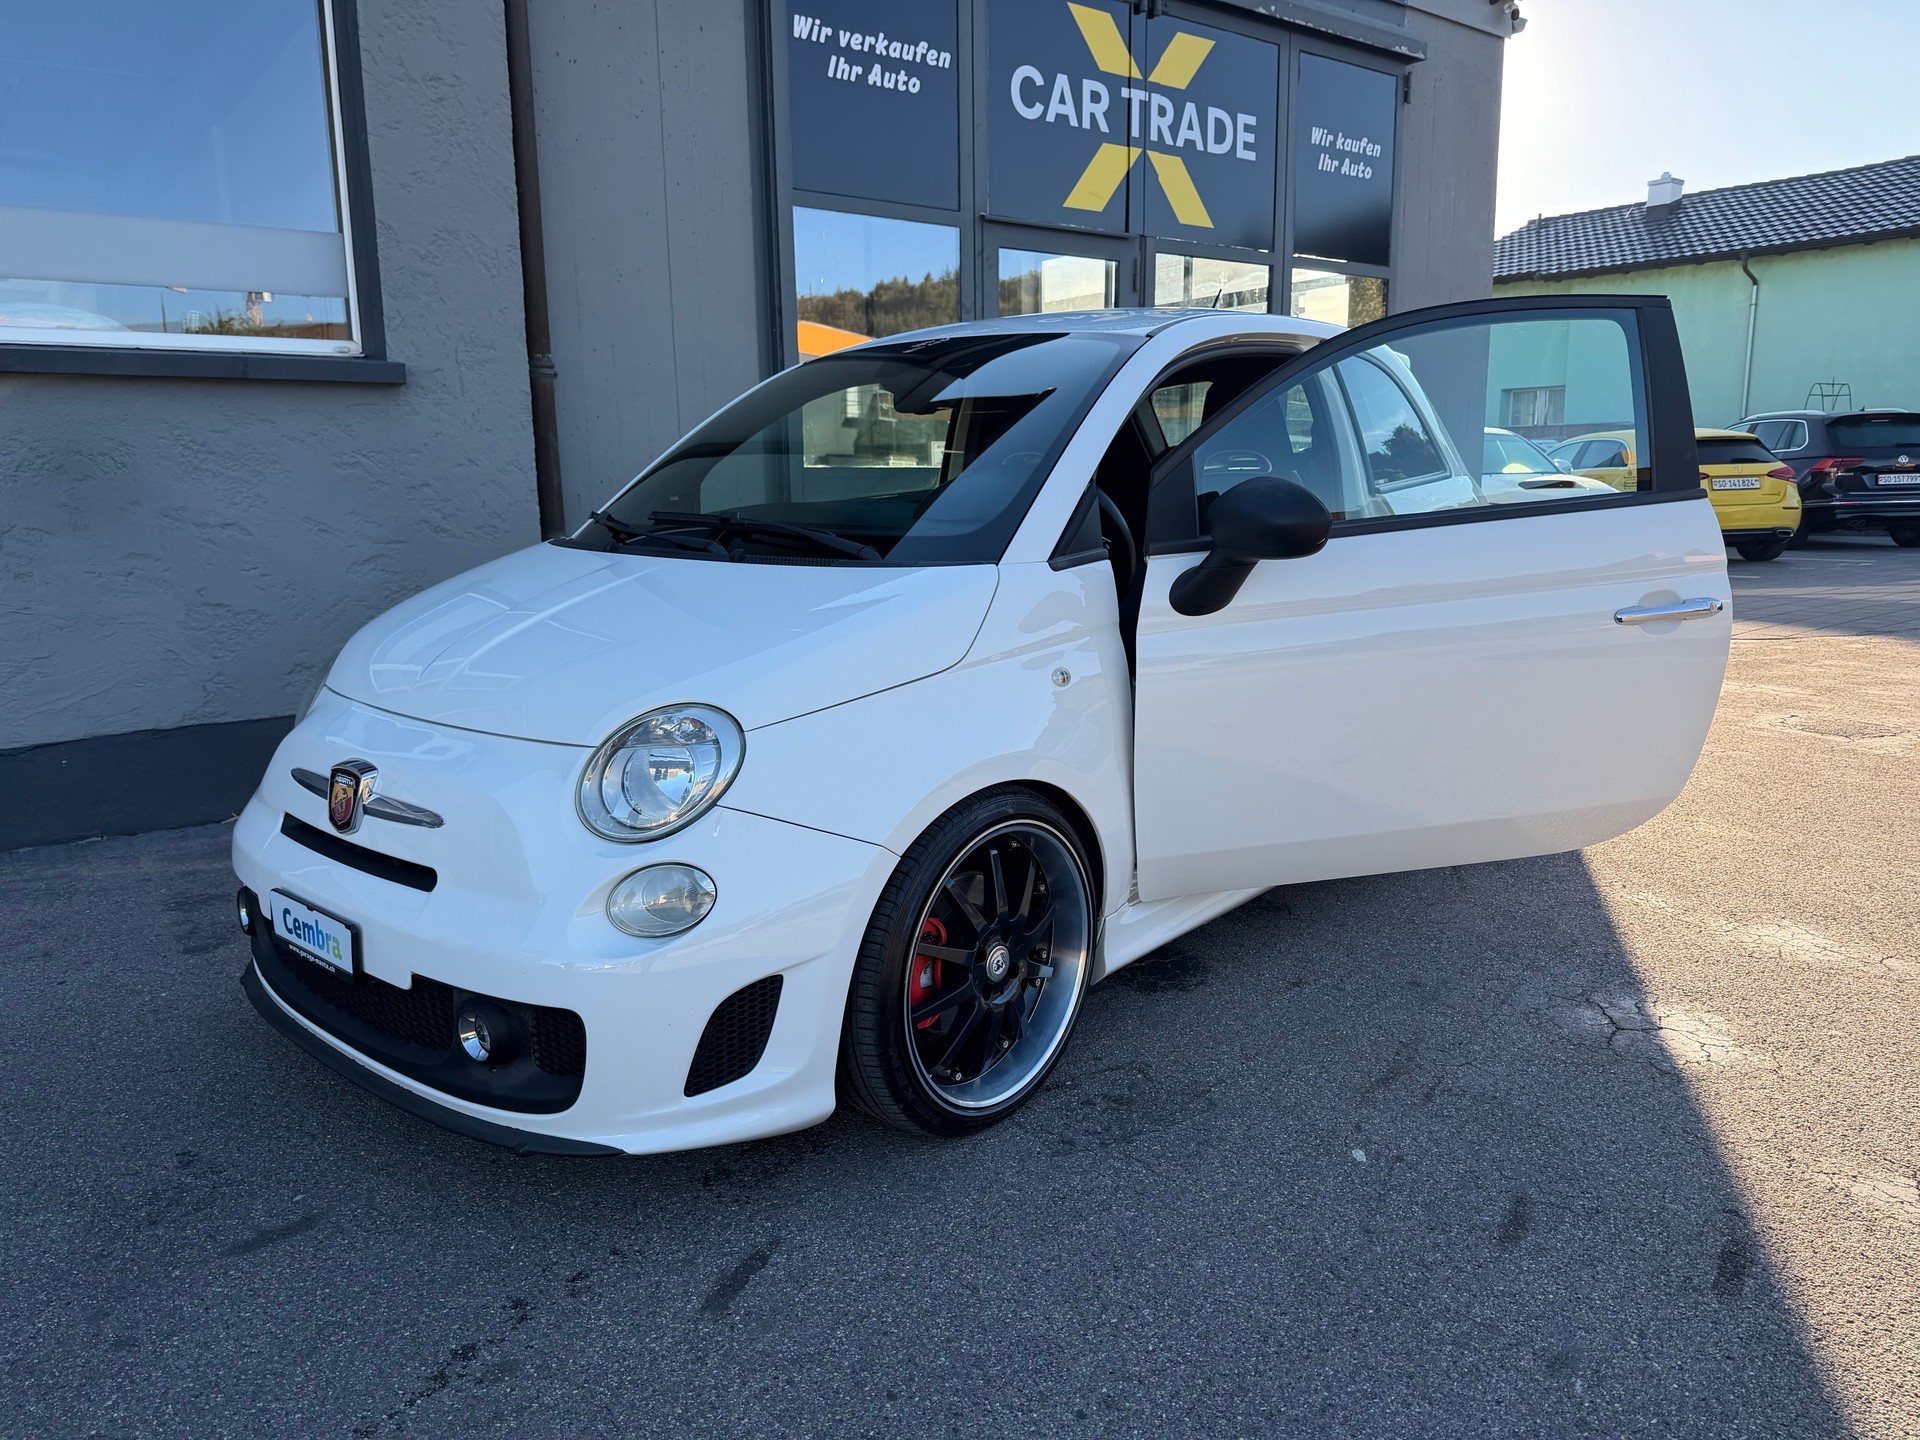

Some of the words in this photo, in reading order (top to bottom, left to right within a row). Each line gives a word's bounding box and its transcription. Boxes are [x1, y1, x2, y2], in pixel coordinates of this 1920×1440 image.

[793, 14, 833, 44] Wir
[838, 30, 952, 69] verkaufen
[827, 55, 863, 82] Ihr
[867, 63, 921, 94] Auto
[1010, 64, 1110, 133] CAR
[1121, 86, 1257, 161] TRADE
[1311, 126, 1334, 147] Wir
[1336, 132, 1381, 158] kaufen
[1318, 153, 1339, 173] Ihr
[1341, 157, 1372, 179] Auto
[282, 907, 343, 961] Cembra
